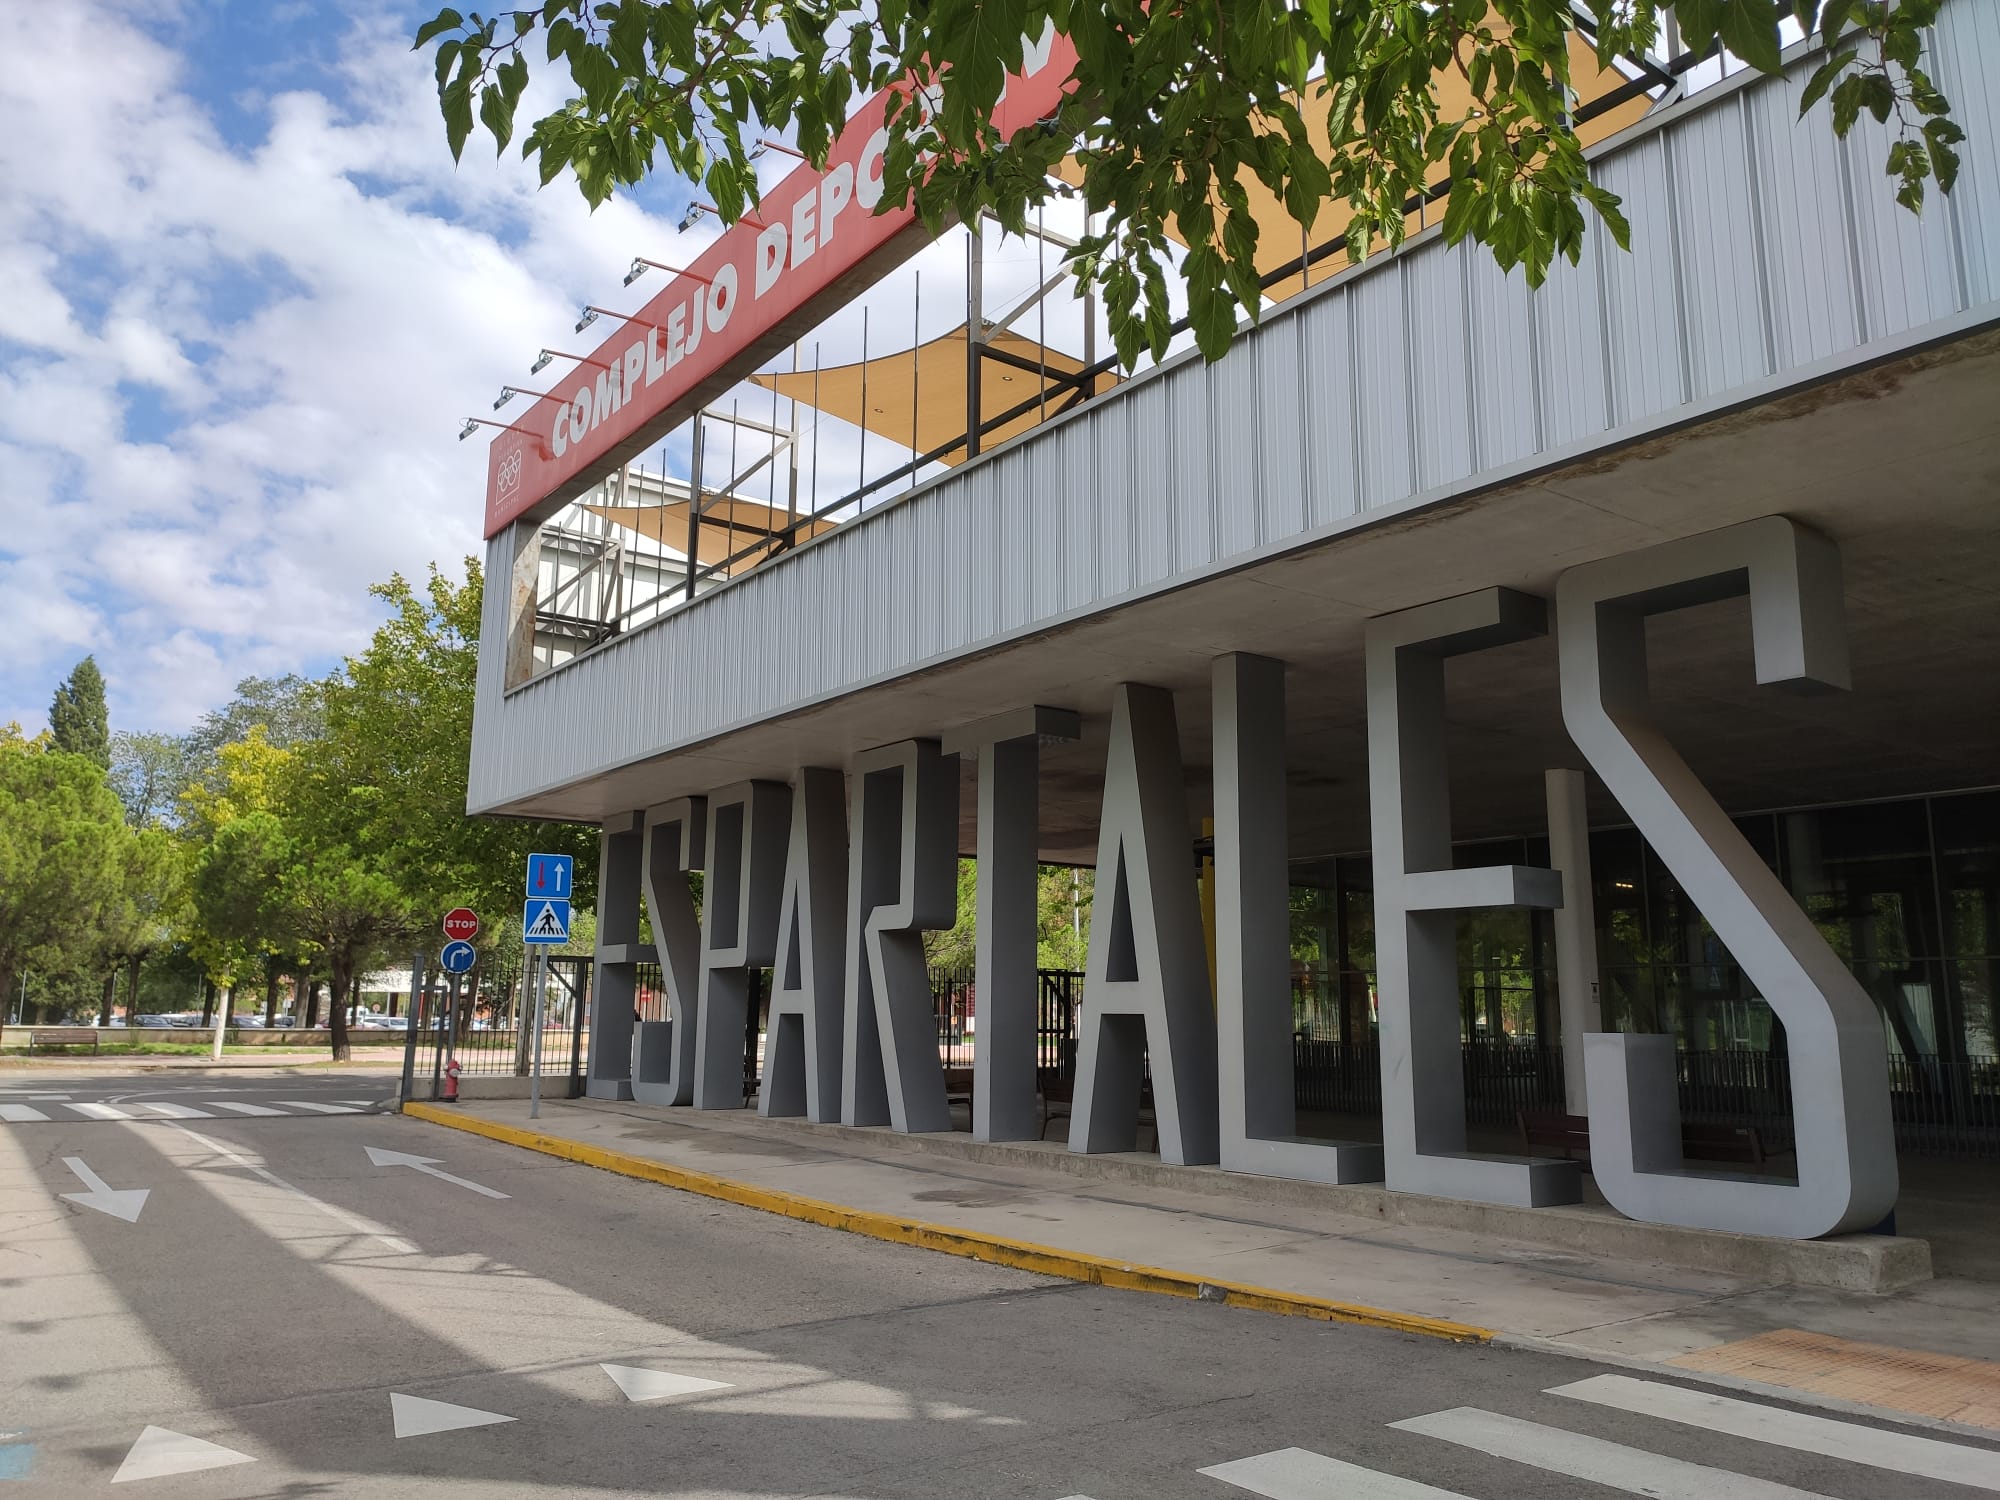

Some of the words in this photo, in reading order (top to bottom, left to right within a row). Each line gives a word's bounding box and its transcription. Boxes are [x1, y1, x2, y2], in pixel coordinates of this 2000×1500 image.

[552, 262, 738, 458] COMPLEJO
[446, 919, 476, 929] STOP
[586, 514, 1899, 1241] ESPARTALES
